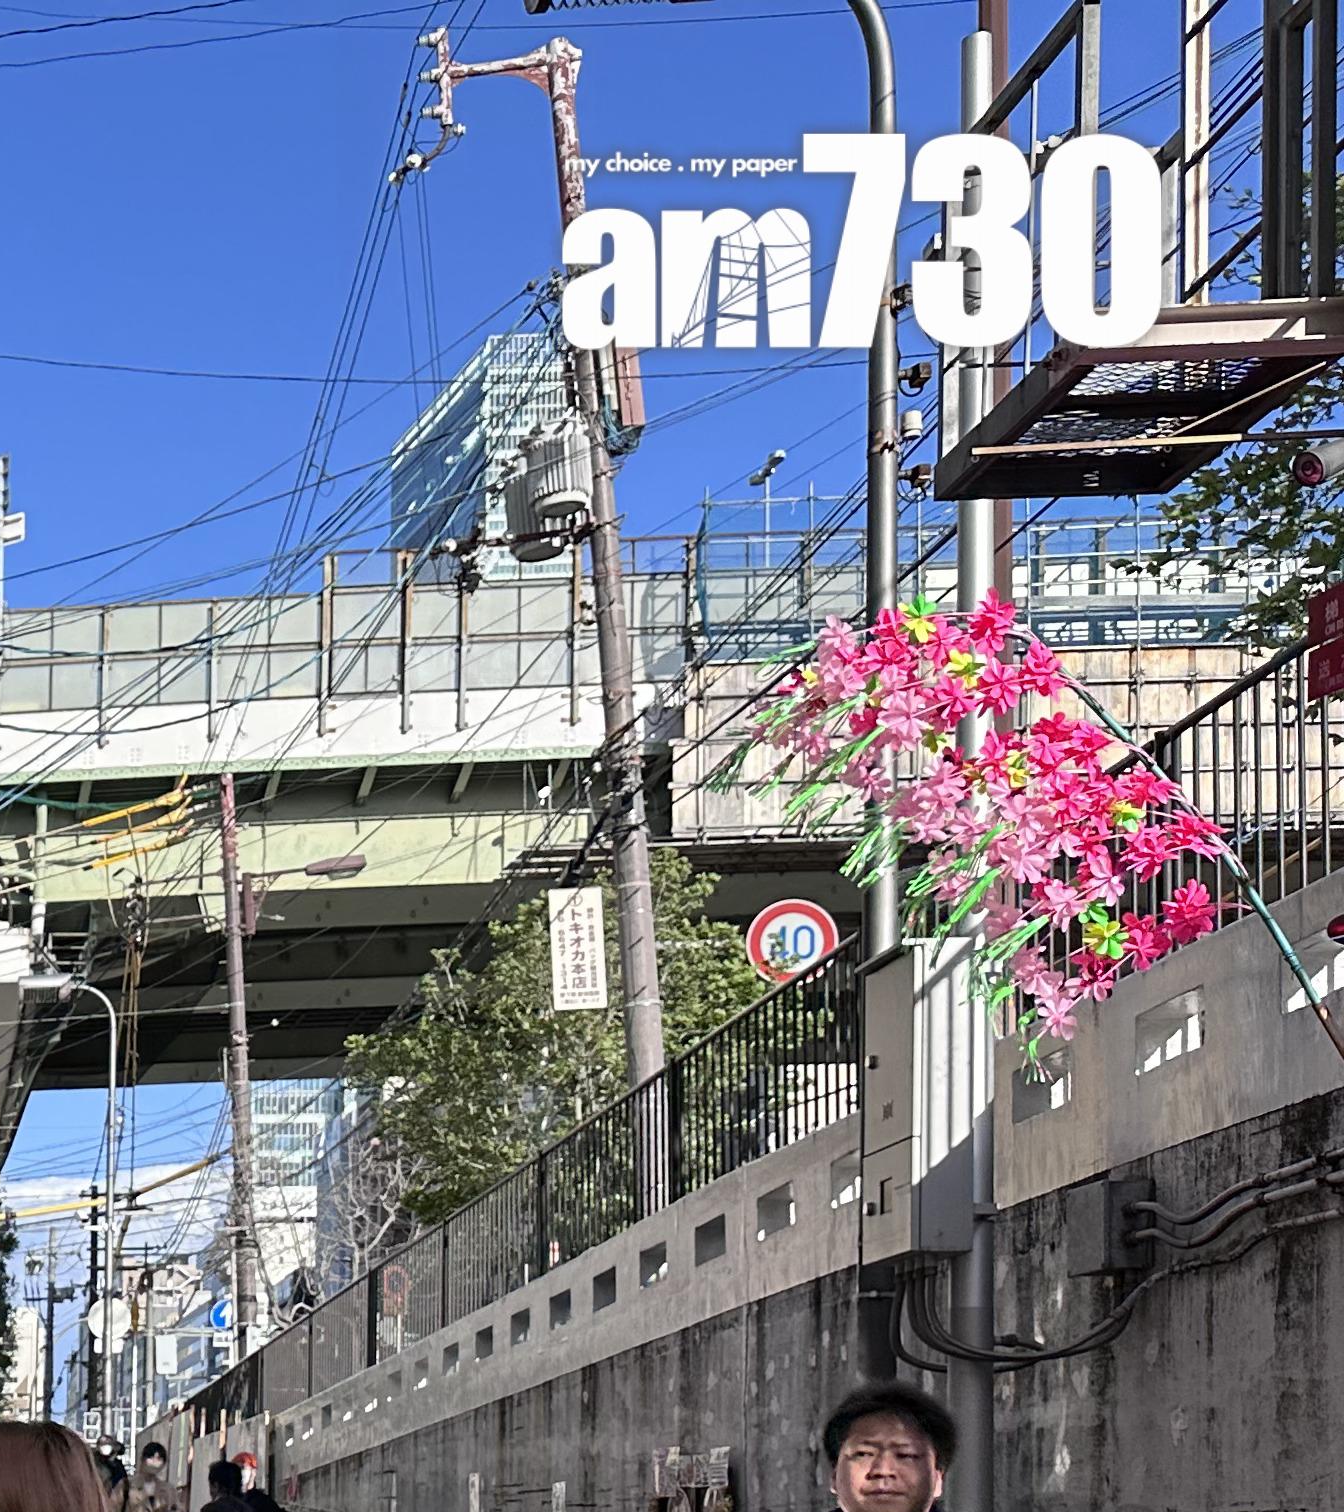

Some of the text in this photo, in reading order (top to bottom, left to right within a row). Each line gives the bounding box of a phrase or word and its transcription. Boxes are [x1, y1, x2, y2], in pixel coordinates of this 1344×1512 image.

[569, 908, 586, 988] トキオカ本店
